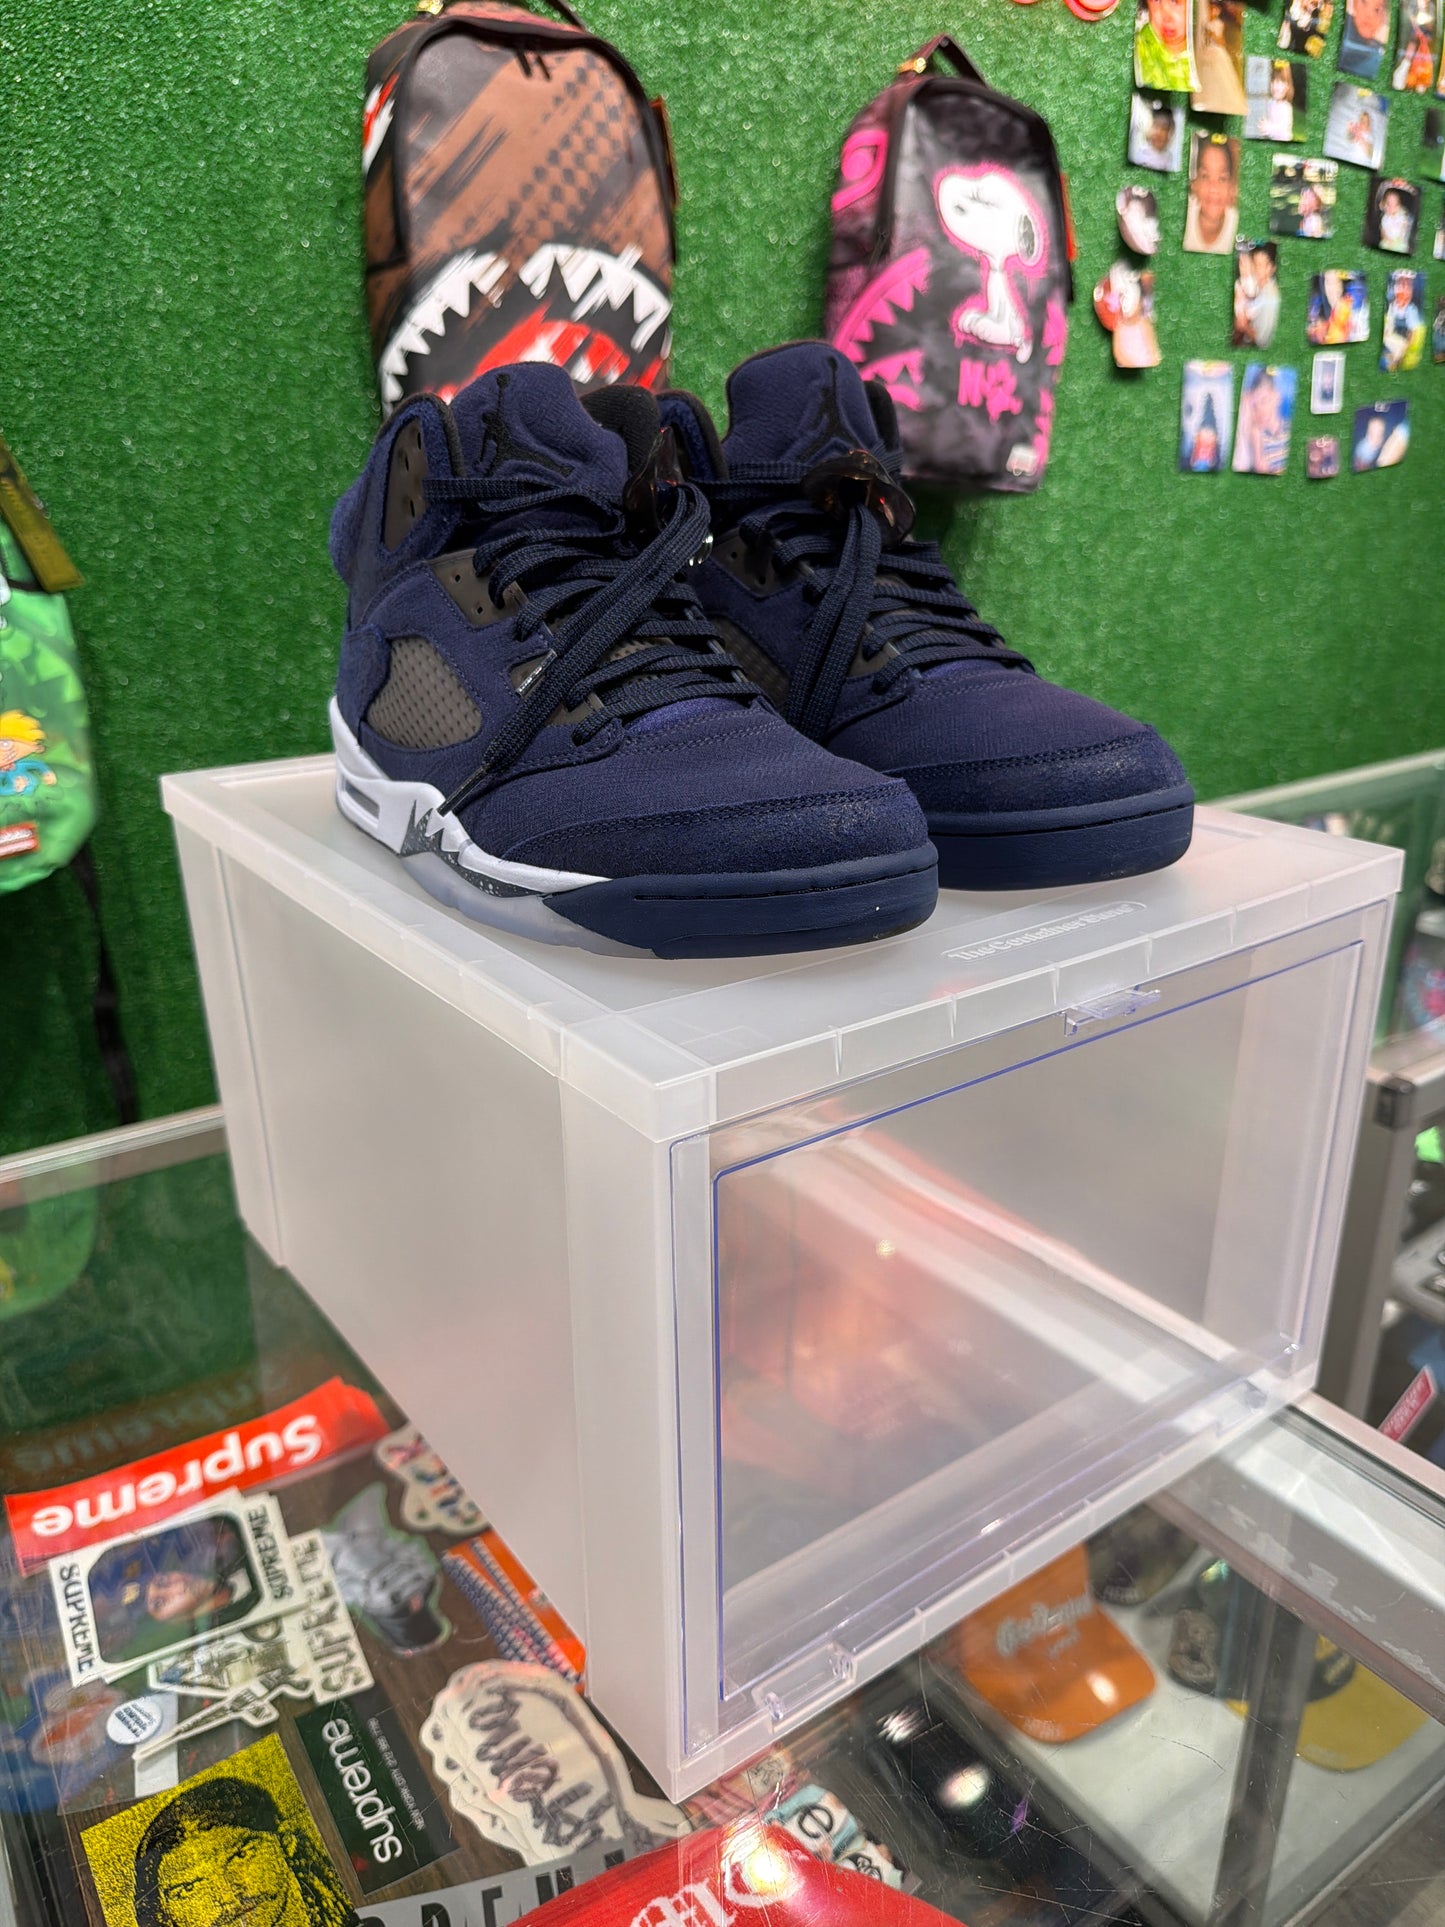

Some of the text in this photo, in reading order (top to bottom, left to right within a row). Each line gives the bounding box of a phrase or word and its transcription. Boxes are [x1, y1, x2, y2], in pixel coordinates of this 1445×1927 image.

[31, 1415, 323, 1537] Supreme
[248, 1507, 294, 1600] SUPREME
[58, 1561, 94, 1673] SUPREME
[300, 1539, 365, 1693] SUPREME
[321, 1717, 402, 1863] supreme
